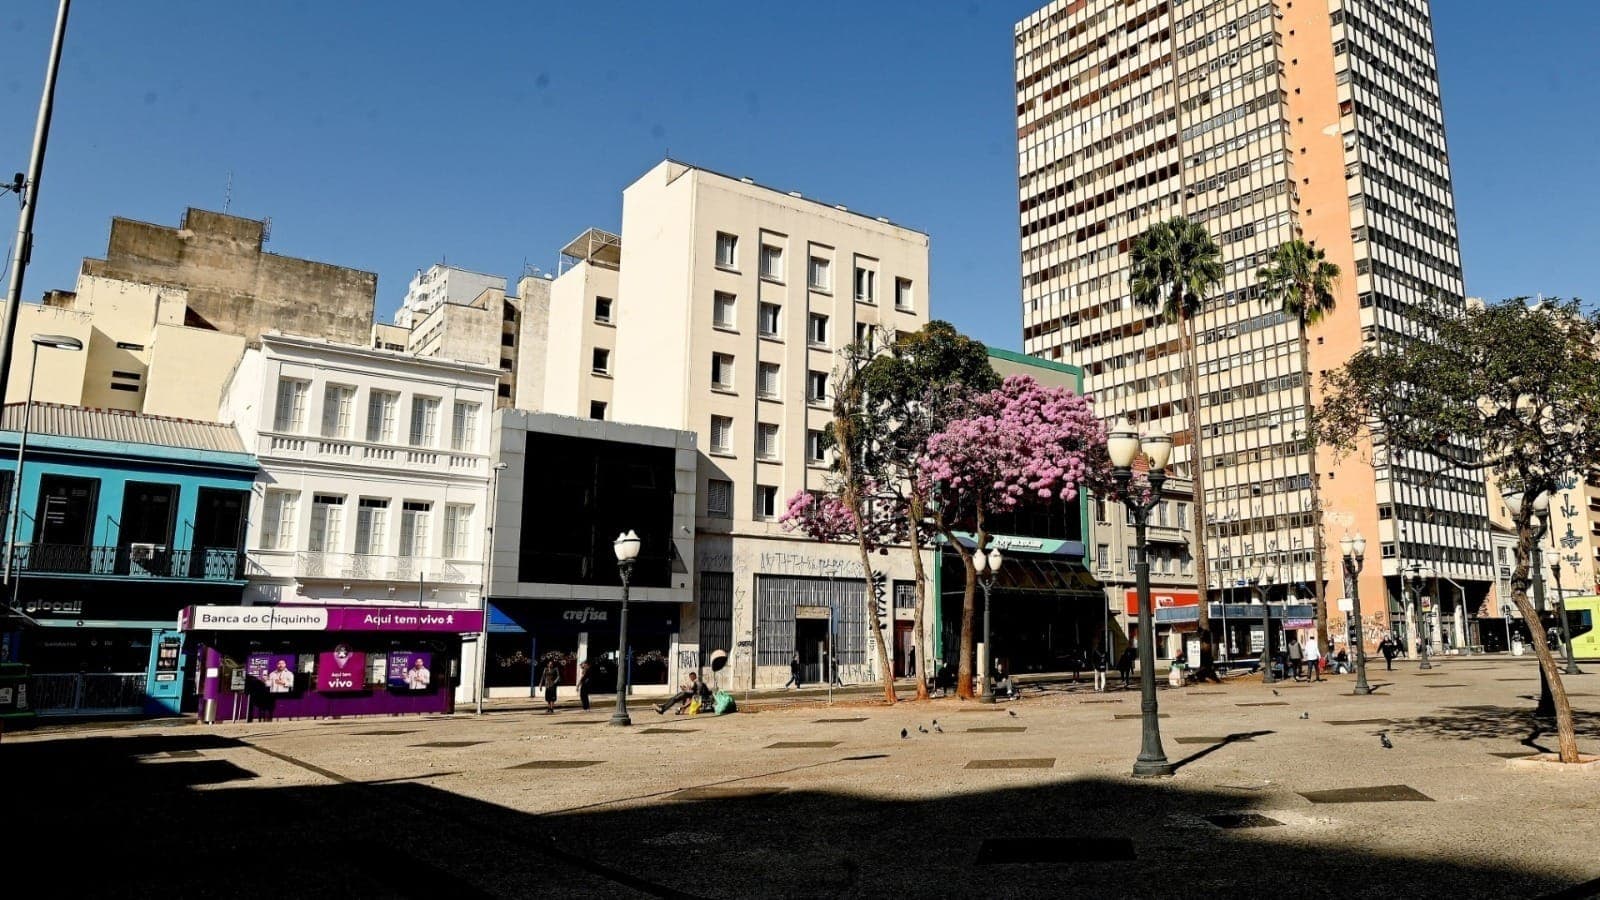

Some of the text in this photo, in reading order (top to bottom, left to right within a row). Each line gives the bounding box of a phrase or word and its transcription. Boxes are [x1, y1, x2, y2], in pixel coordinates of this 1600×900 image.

[202, 614, 321, 625] Banca do Chiquinho
[364, 614, 445, 626] Aqui tem vivo
[563, 606, 608, 624] crefisa
[328, 678, 353, 688] vivo
